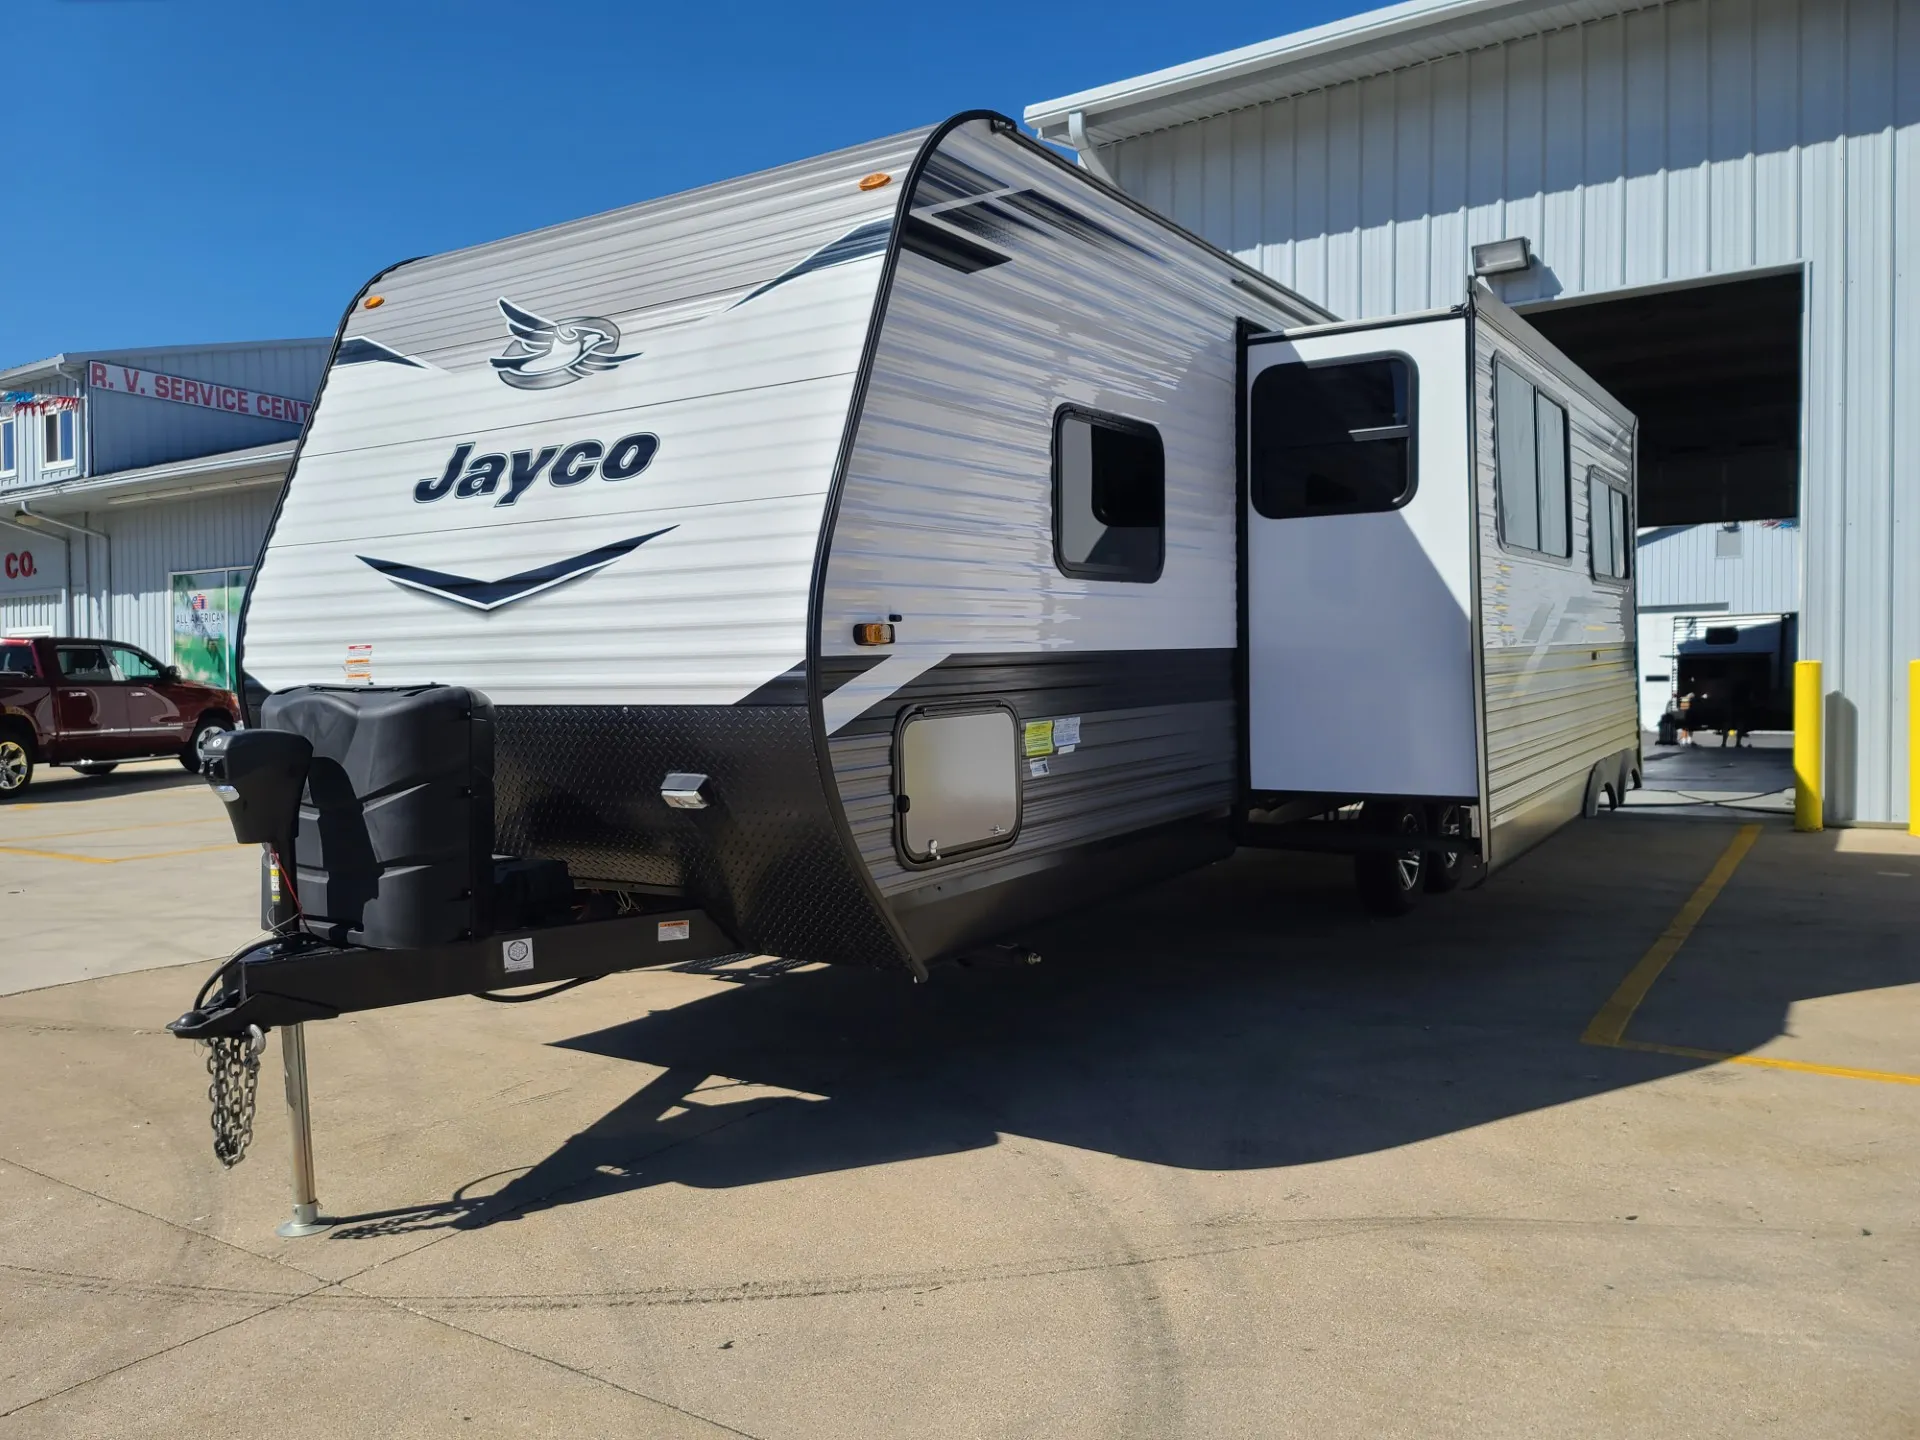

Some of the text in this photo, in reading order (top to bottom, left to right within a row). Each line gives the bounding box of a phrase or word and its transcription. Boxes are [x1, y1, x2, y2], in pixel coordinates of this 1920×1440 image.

[91, 362, 312, 422] R. V. SERVICE CENT
[413, 431, 661, 508] Jayco
[5, 551, 37, 579] CO.
